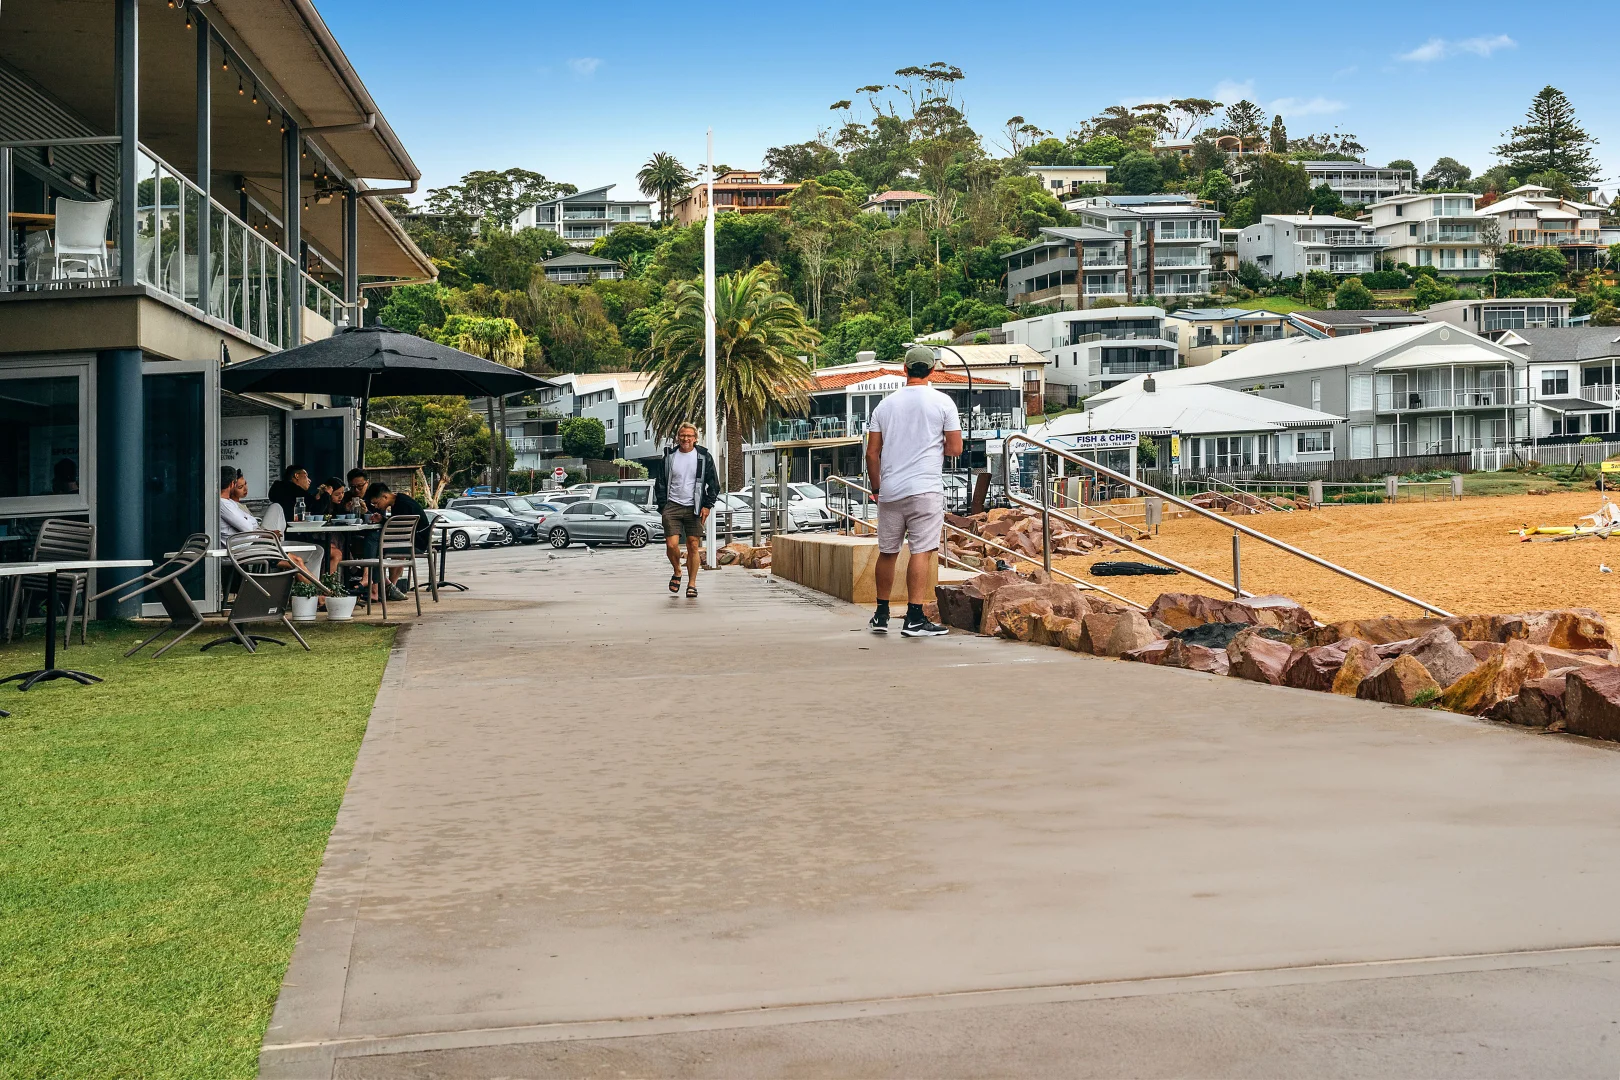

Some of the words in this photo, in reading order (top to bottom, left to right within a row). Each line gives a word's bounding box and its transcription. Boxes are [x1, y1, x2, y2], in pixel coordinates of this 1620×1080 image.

[857, 383, 876, 391] AVOCA
[879, 382, 899, 390] BEACH
[1077, 435, 1097, 443] FISH
[1100, 434, 1106, 442] &
[1109, 433, 1137, 442] CHIPS
